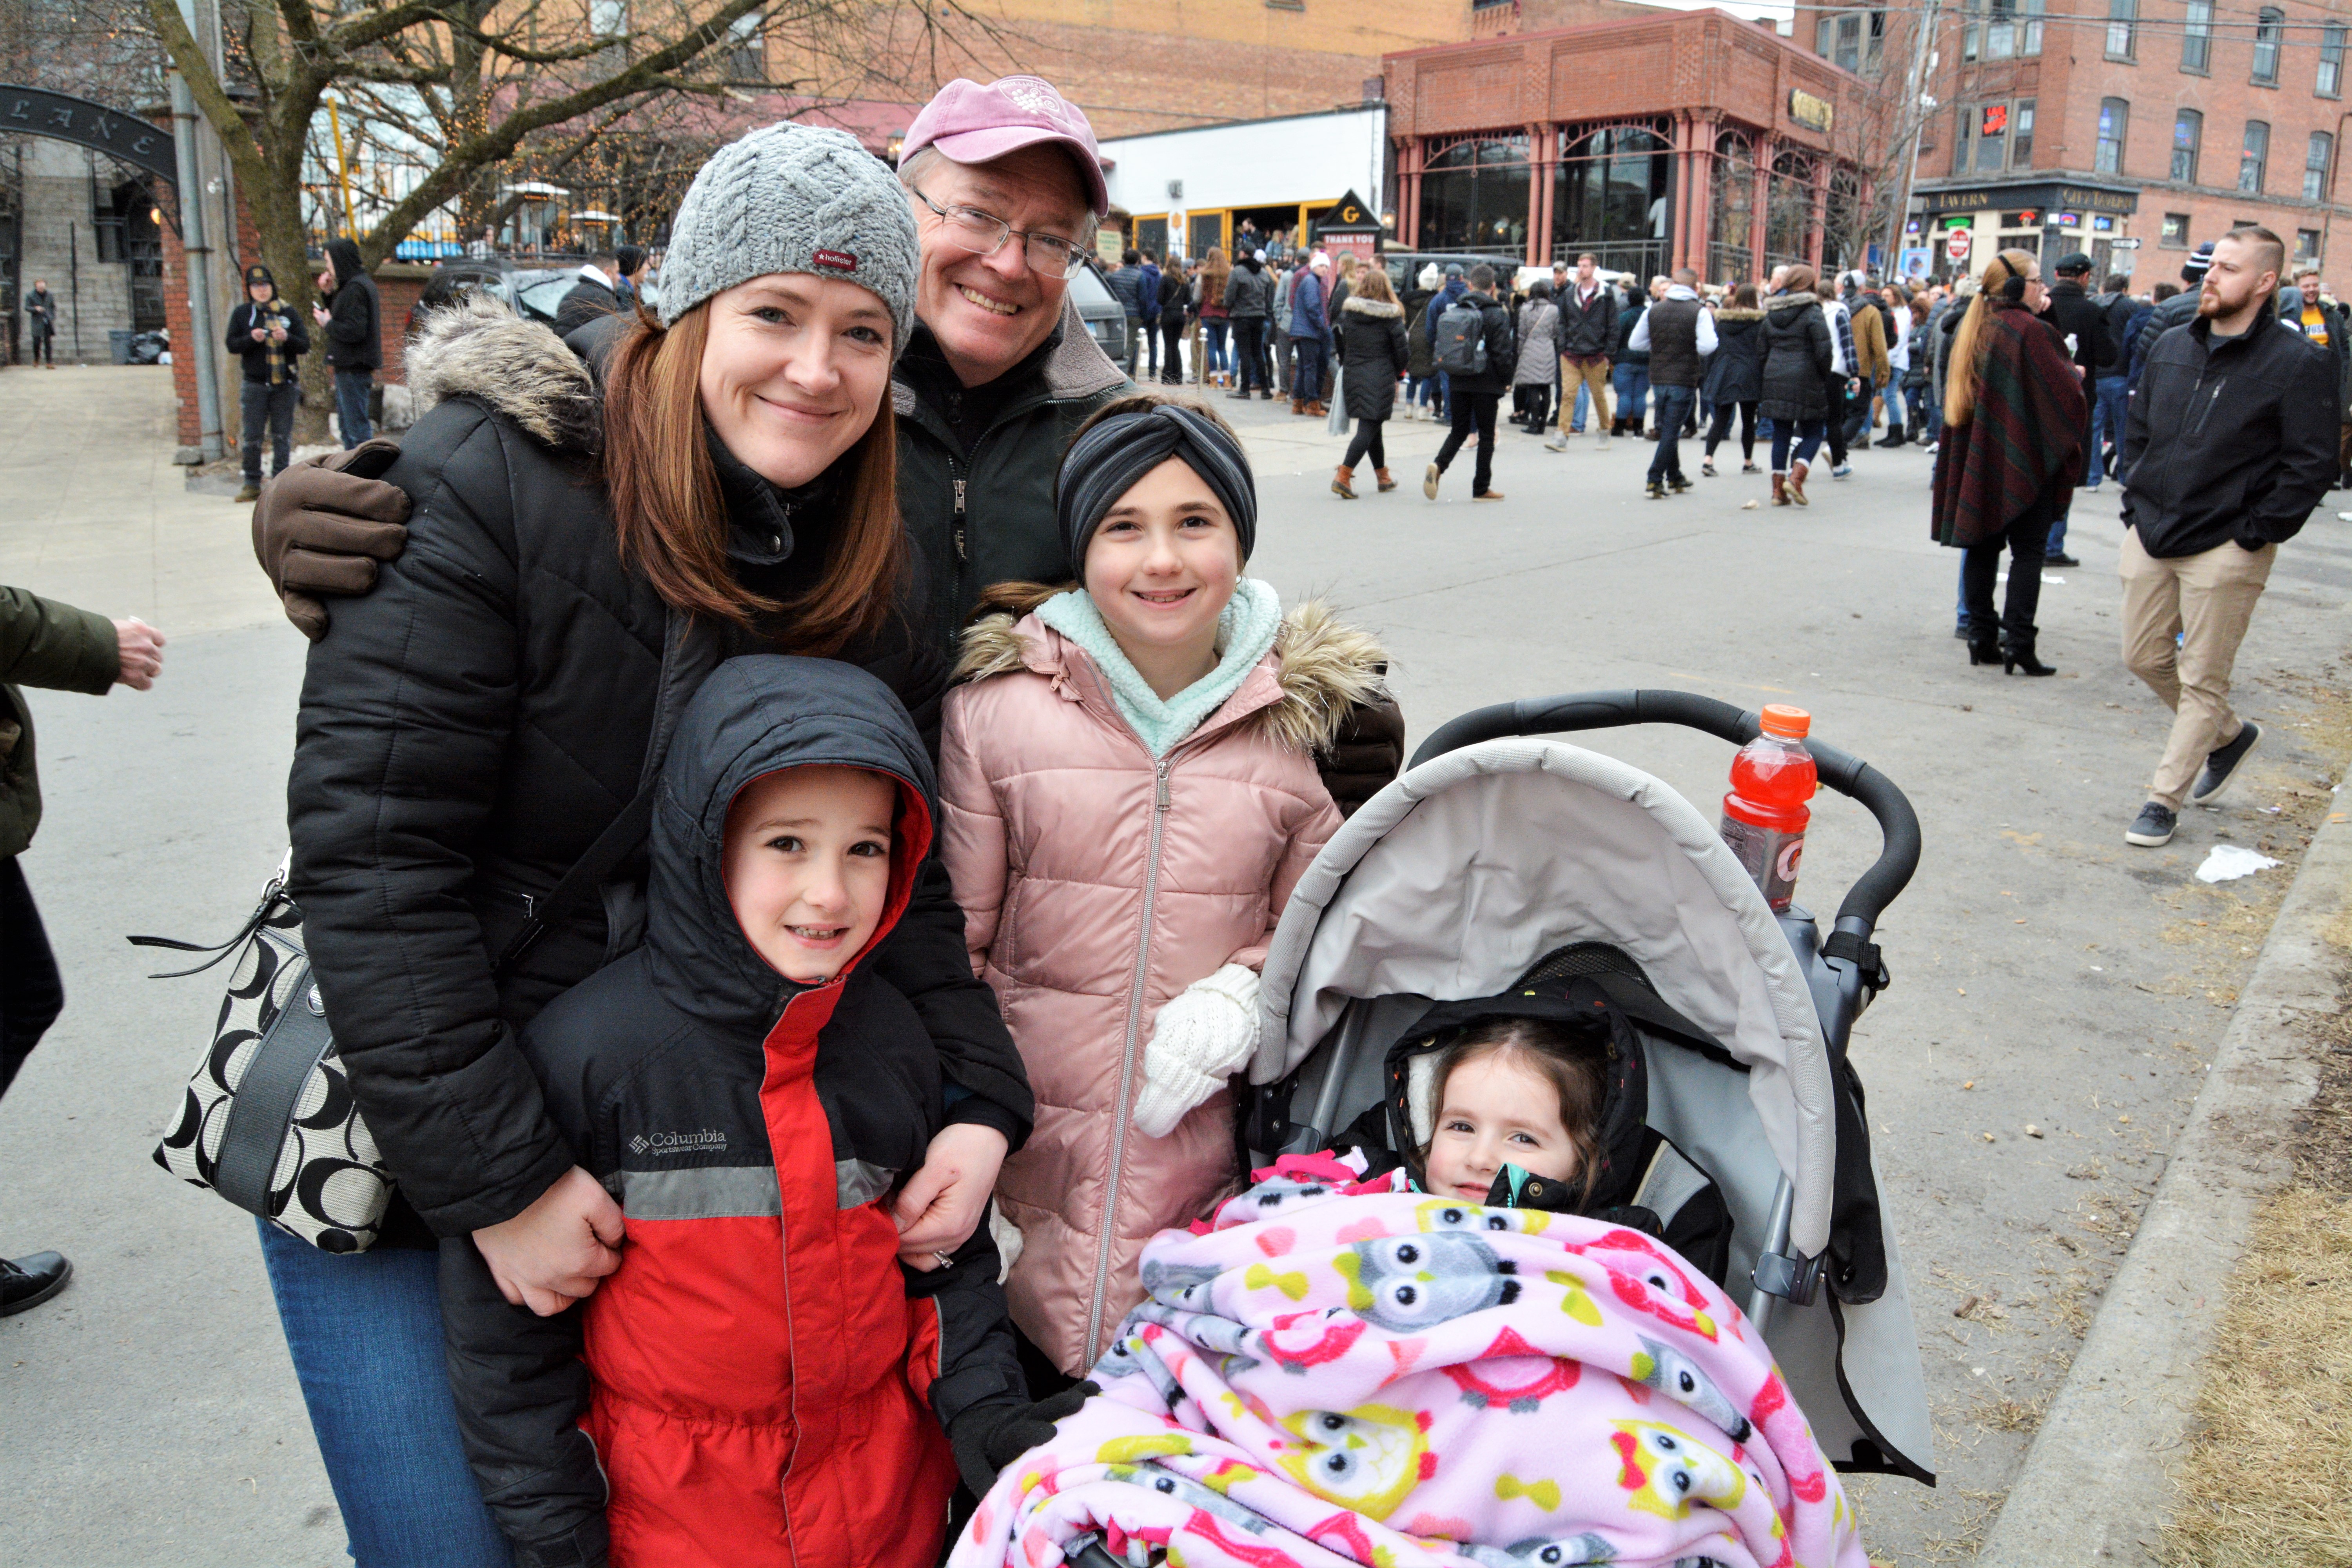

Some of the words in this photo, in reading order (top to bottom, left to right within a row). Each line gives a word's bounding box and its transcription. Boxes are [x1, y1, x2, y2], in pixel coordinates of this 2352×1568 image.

[1343, 205, 1360, 223] G
[1325, 235, 1354, 244] THANK
[1356, 234, 1375, 244] YOU
[825, 254, 852, 265] hollister
[650, 1129, 726, 1147] Columbia
[652, 1145, 693, 1156] Sportswear
[692, 1143, 728, 1152] Company
